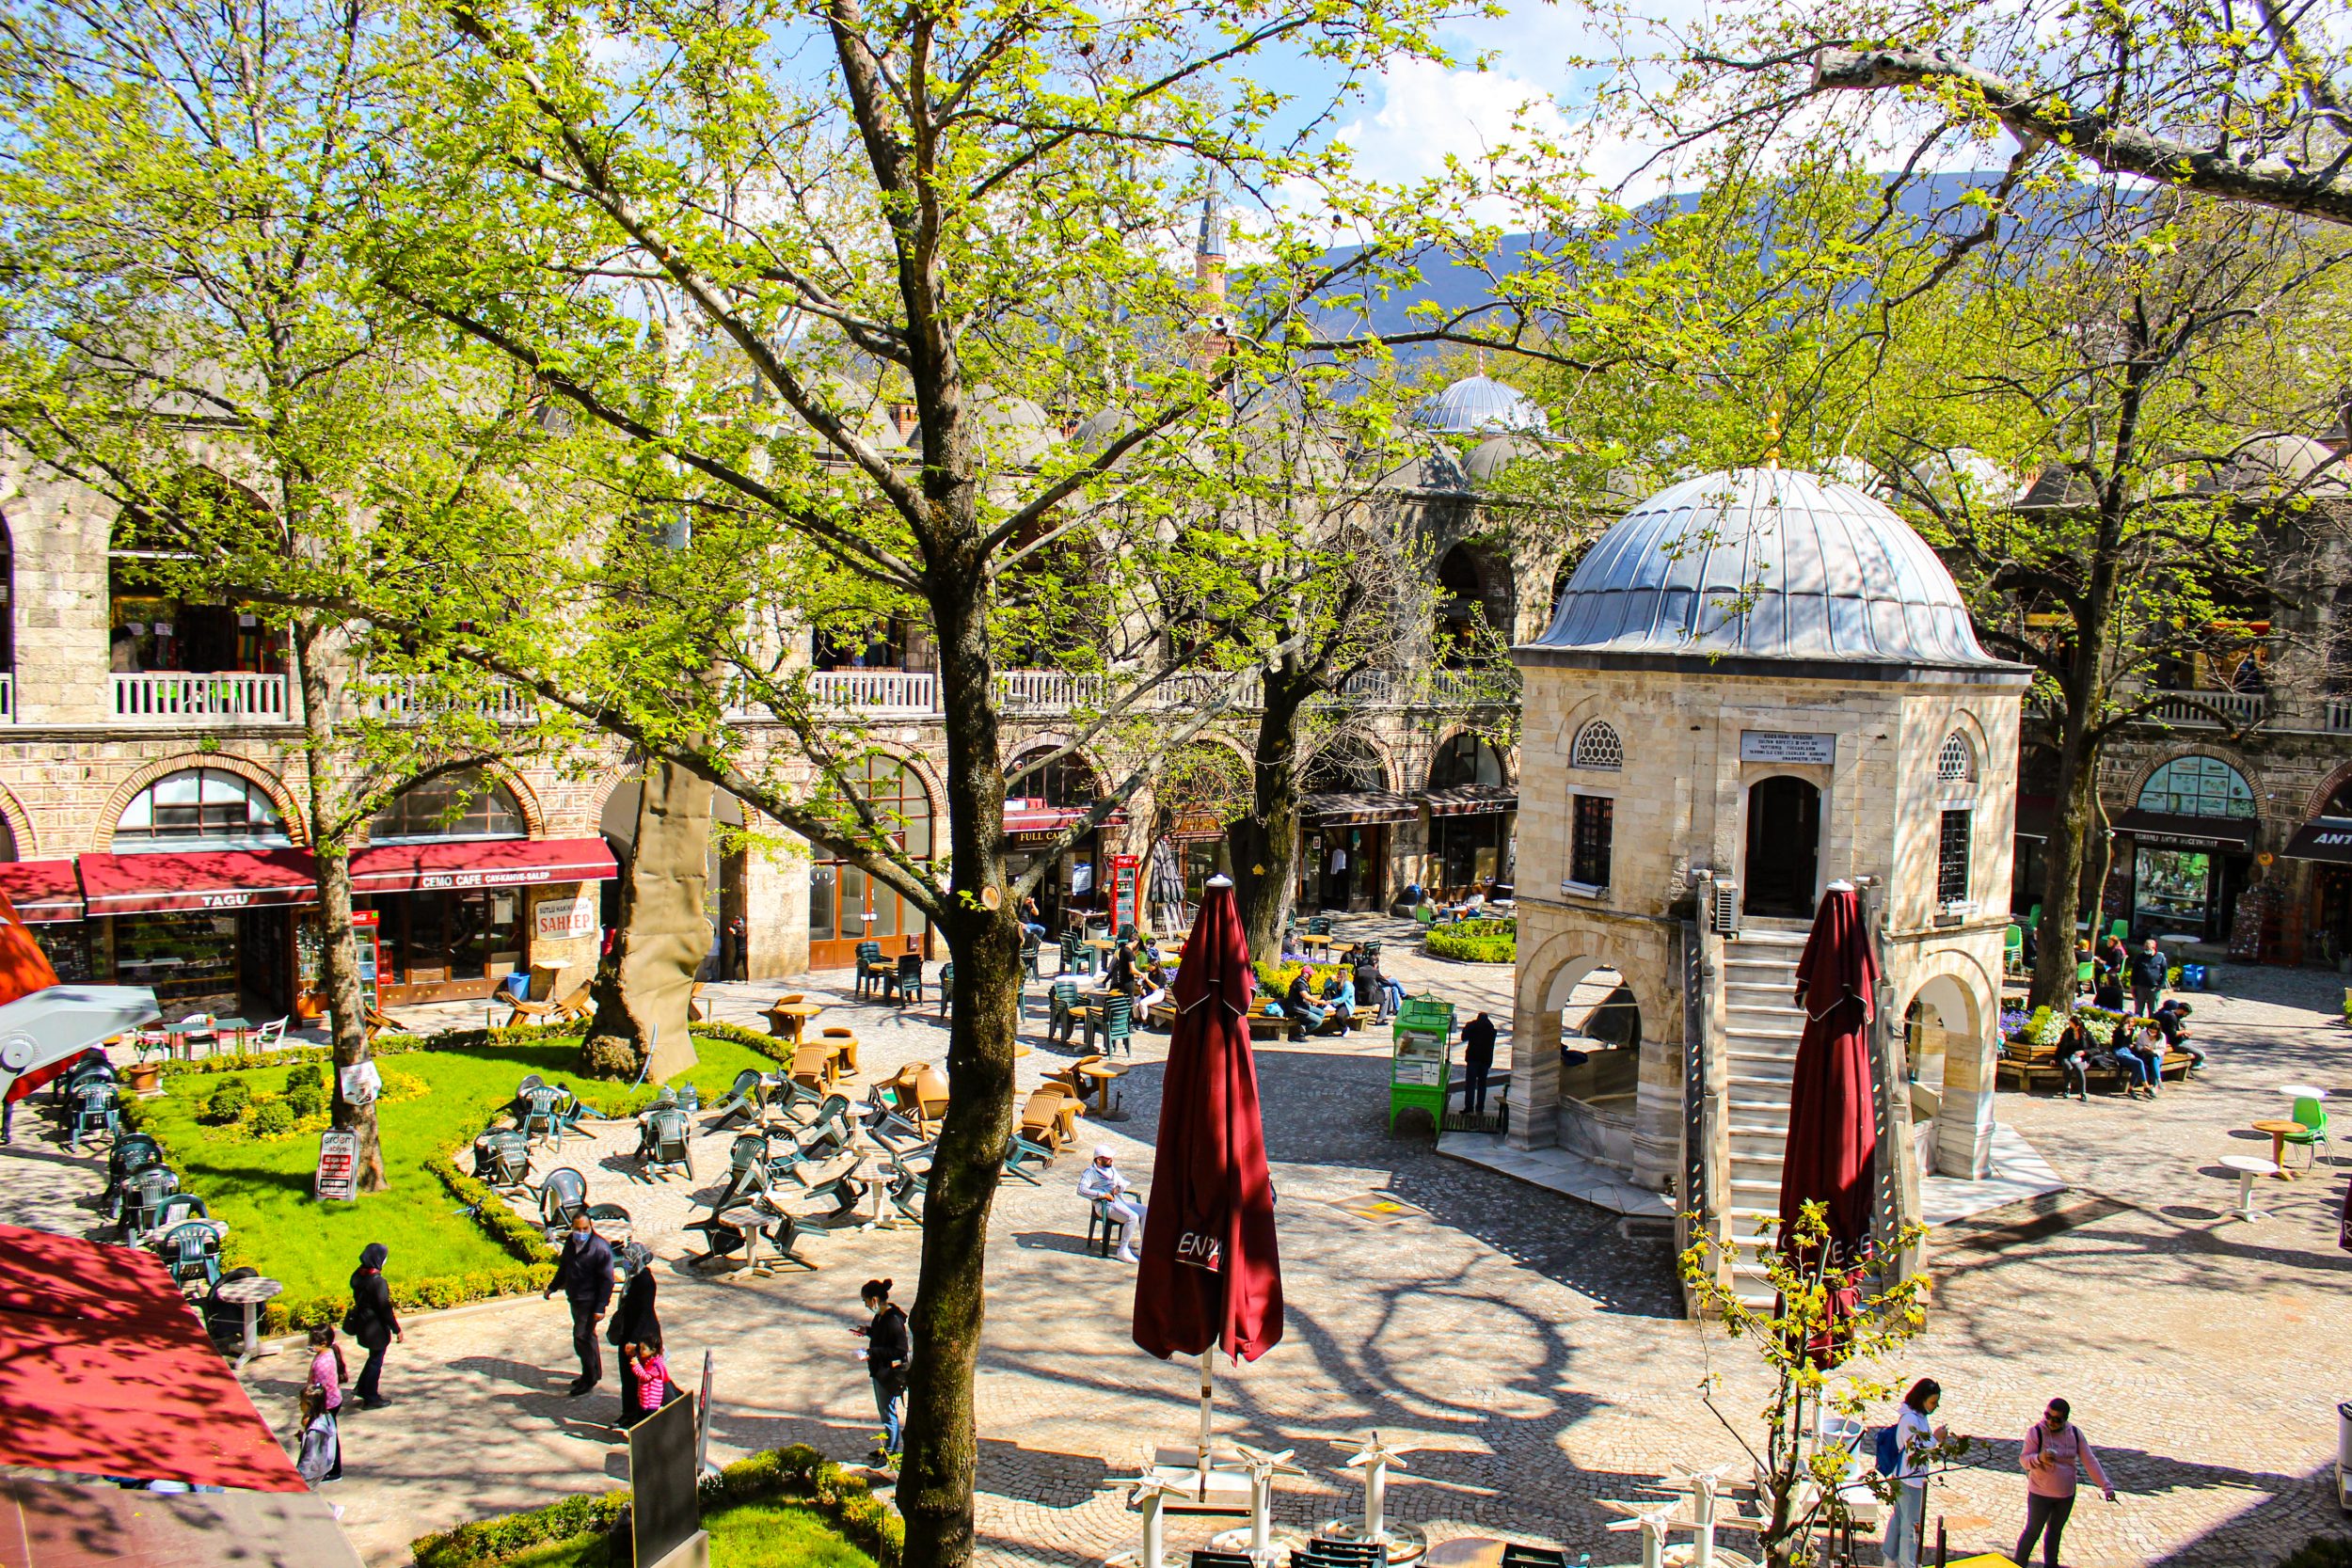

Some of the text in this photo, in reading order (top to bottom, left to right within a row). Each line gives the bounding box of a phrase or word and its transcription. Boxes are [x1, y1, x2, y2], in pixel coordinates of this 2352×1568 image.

[1020, 832, 1042, 841] FULL
[456, 875, 482, 885] CAFE
[201, 894, 248, 907] TAGU
[540, 913, 590, 933] SAHLEP
